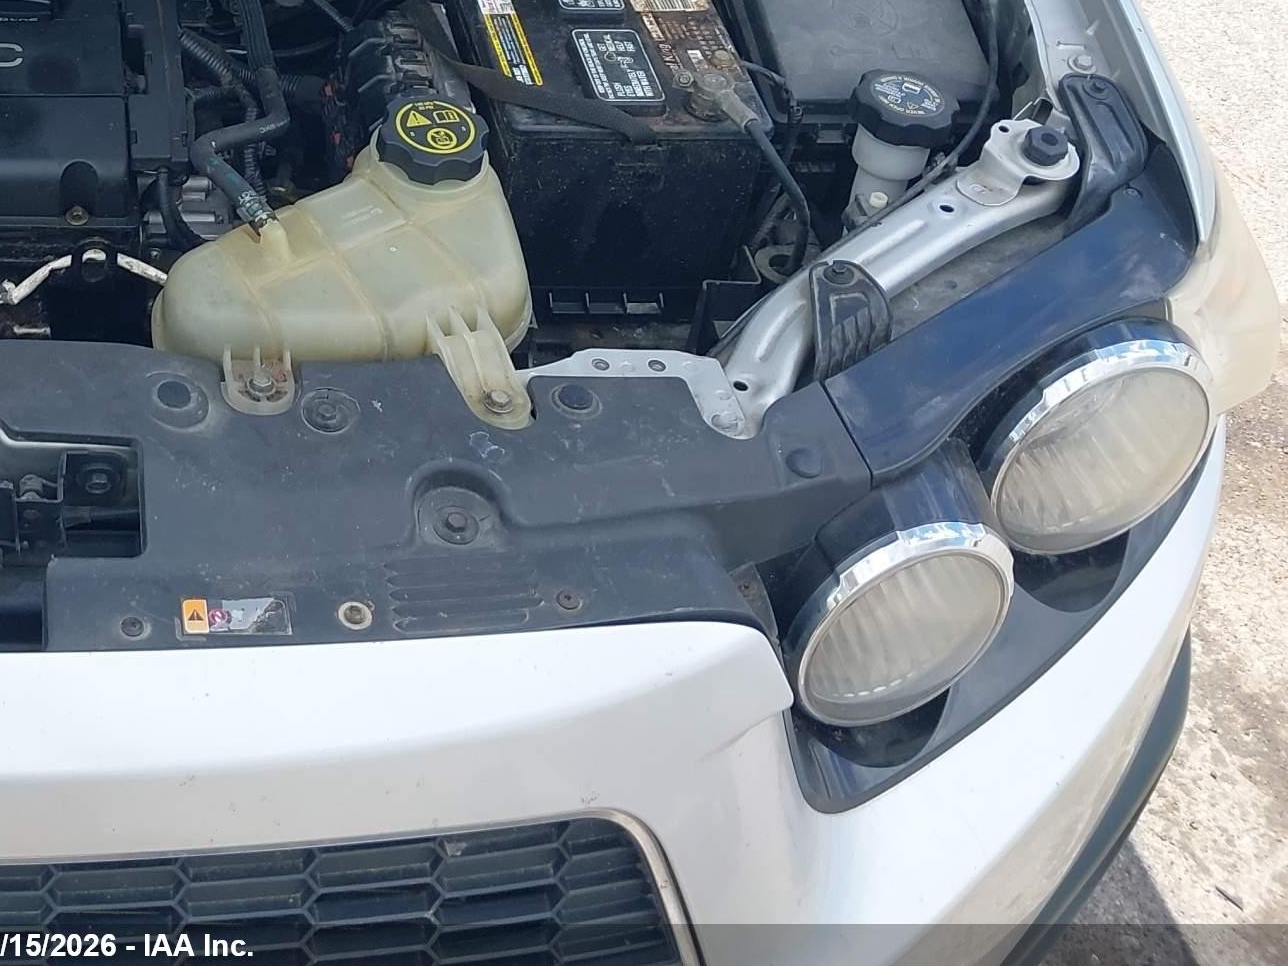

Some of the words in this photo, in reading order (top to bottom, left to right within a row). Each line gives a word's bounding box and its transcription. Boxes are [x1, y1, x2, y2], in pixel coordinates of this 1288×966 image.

[595, 42, 607, 51] GET
[613, 40, 626, 51] HELP
[622, 40, 636, 51] FAST
[635, 69, 650, 85] WATER
[611, 81, 626, 96] FLUSH
[641, 85, 654, 96] WITH
